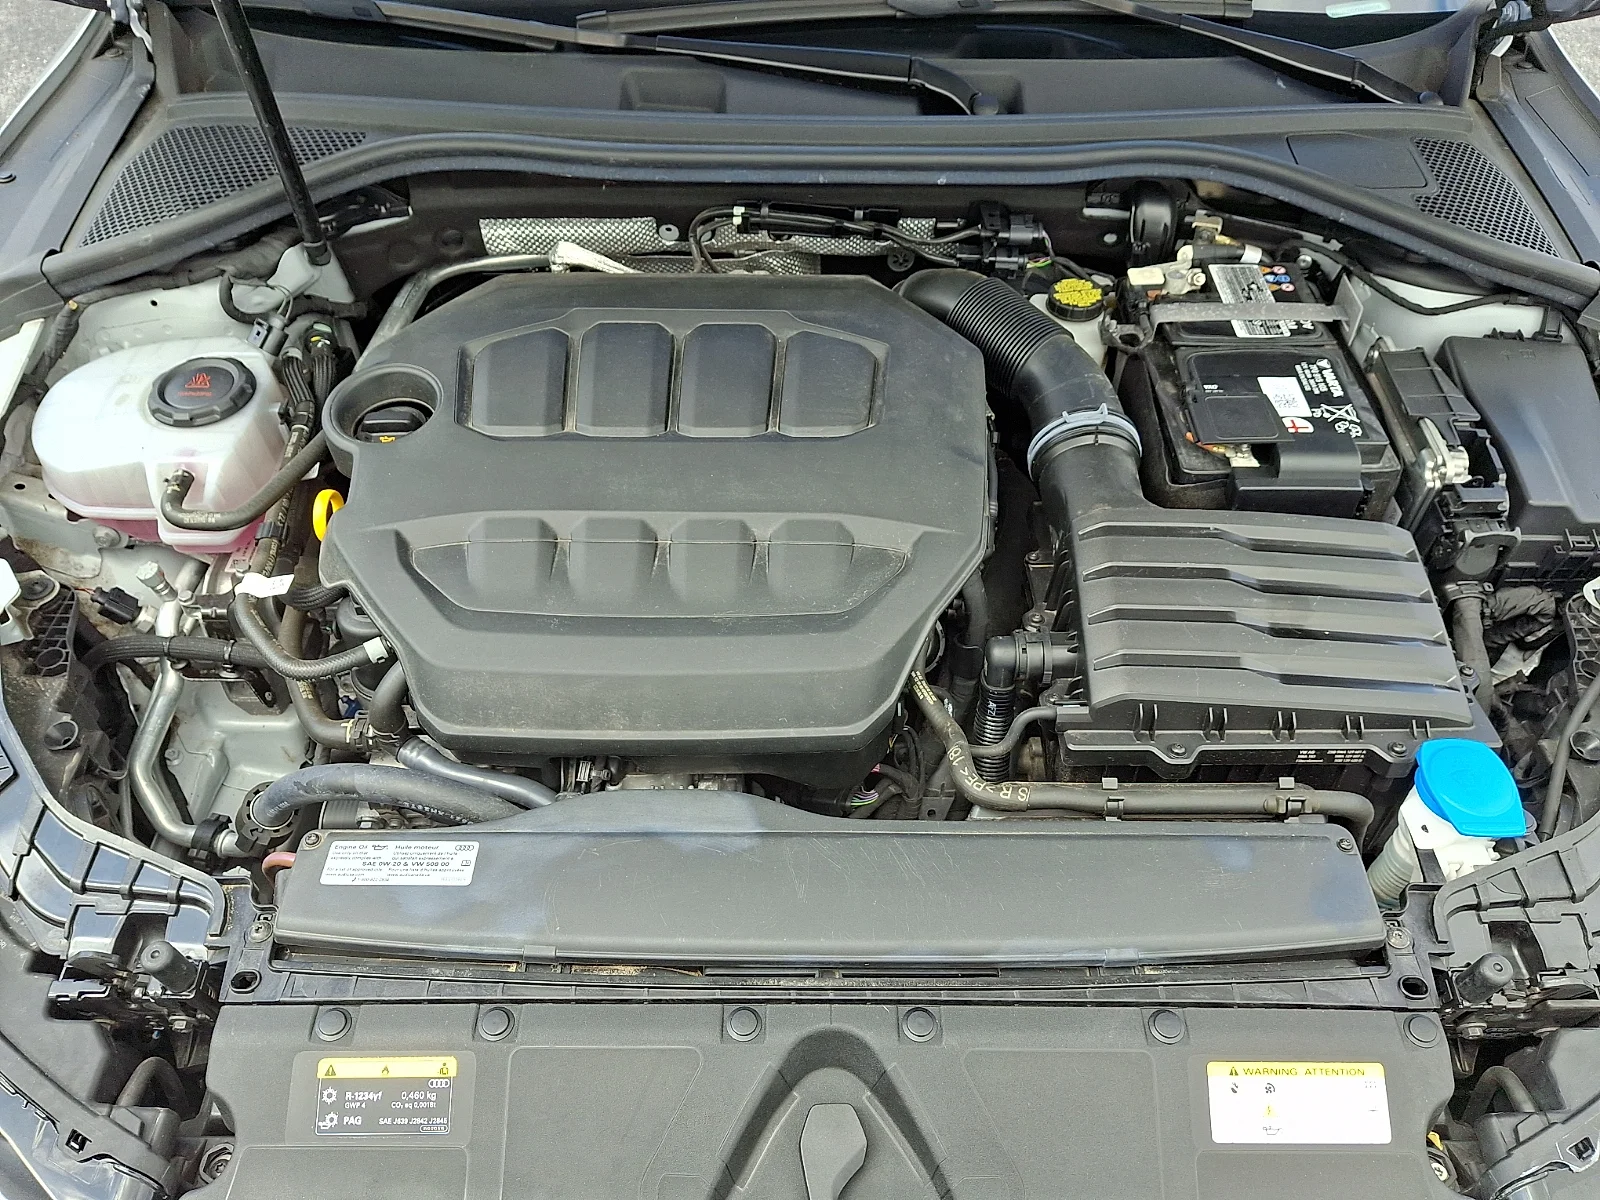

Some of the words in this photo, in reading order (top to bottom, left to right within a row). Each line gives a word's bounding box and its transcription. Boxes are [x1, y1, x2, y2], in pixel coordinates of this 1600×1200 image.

[1322, 368, 1344, 398] VARTA
[1243, 1067, 1298, 1076] WARNING
[1304, 1067, 1366, 1077] ATTENTION
[345, 1091, 383, 1101] R-1234yf
[401, 1091, 425, 1100] 0,460
[426, 1091, 437, 1101] kg
[343, 1115, 362, 1125] PAG
[379, 1117, 392, 1125] SAE
